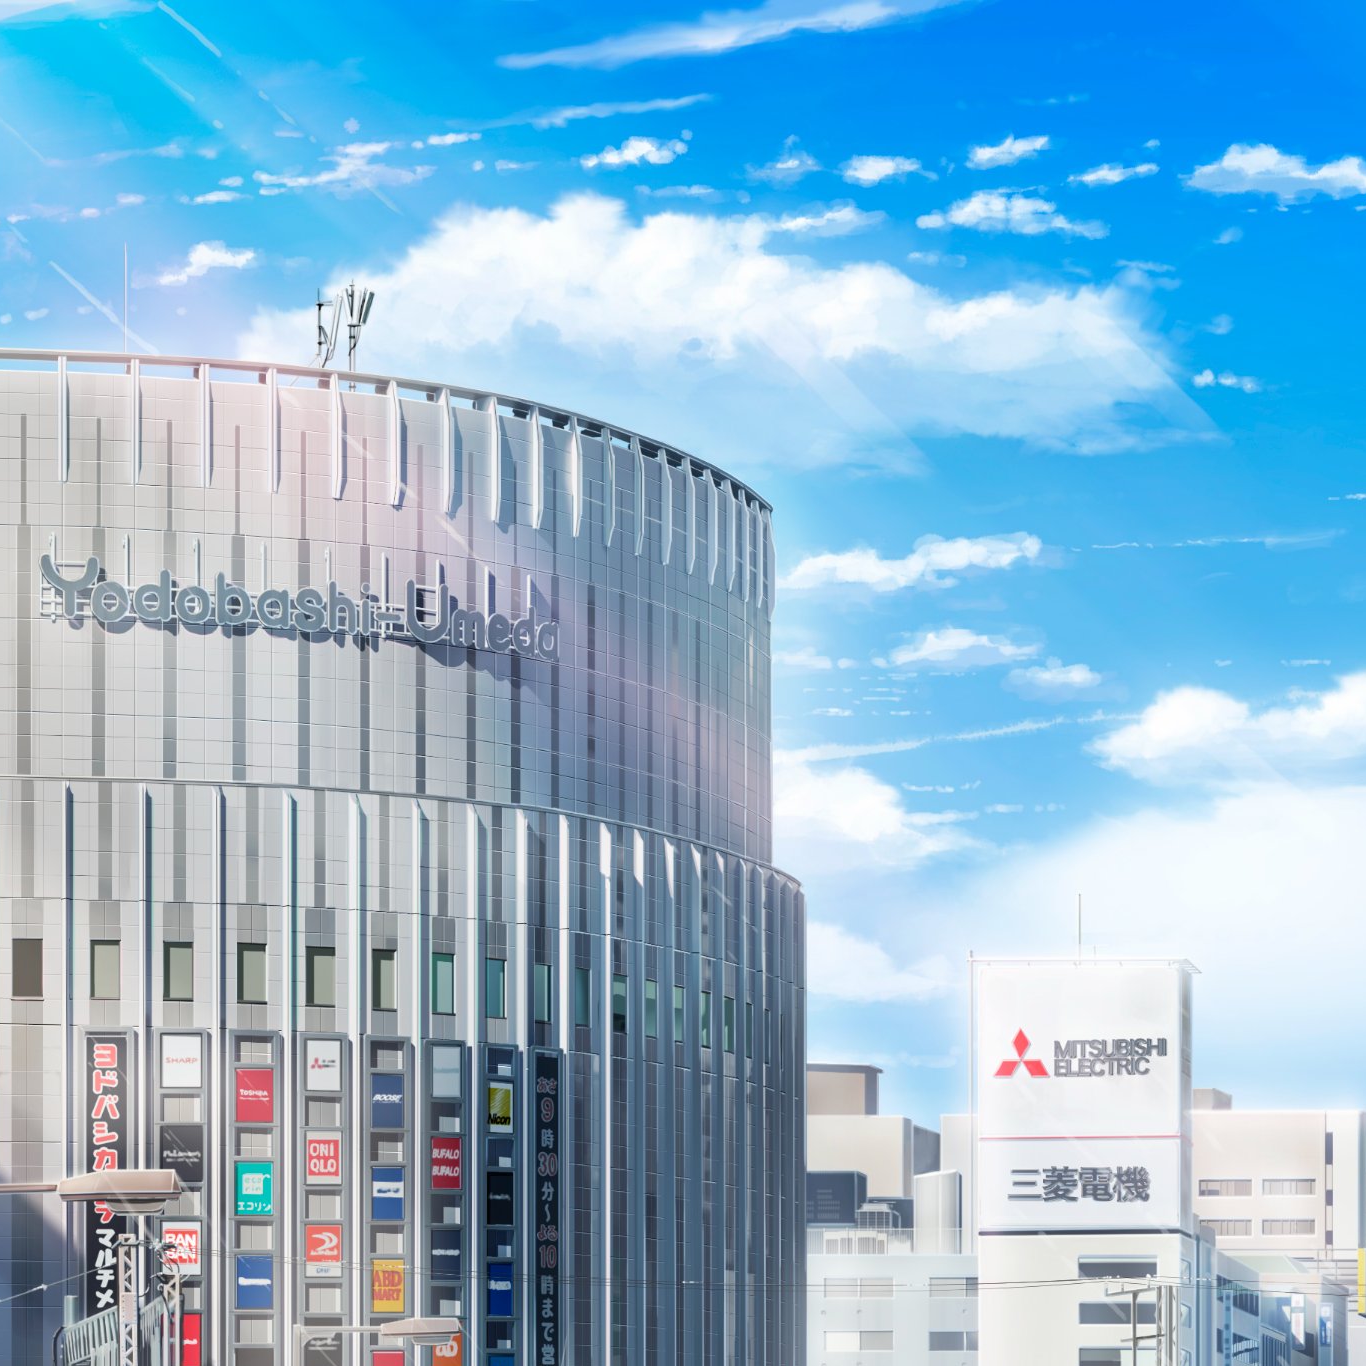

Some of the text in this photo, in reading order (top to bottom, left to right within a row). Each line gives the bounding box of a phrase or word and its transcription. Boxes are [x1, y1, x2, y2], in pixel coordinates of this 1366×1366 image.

[39, 553, 560, 659] Yodobashi-Umeda
[1053, 1037, 1168, 1059] MITSUBISHI
[165, 1056, 198, 1064] SHARP
[1053, 1058, 1151, 1078] ELECTRIC
[1007, 1166, 1151, 1203] 三菱電機
